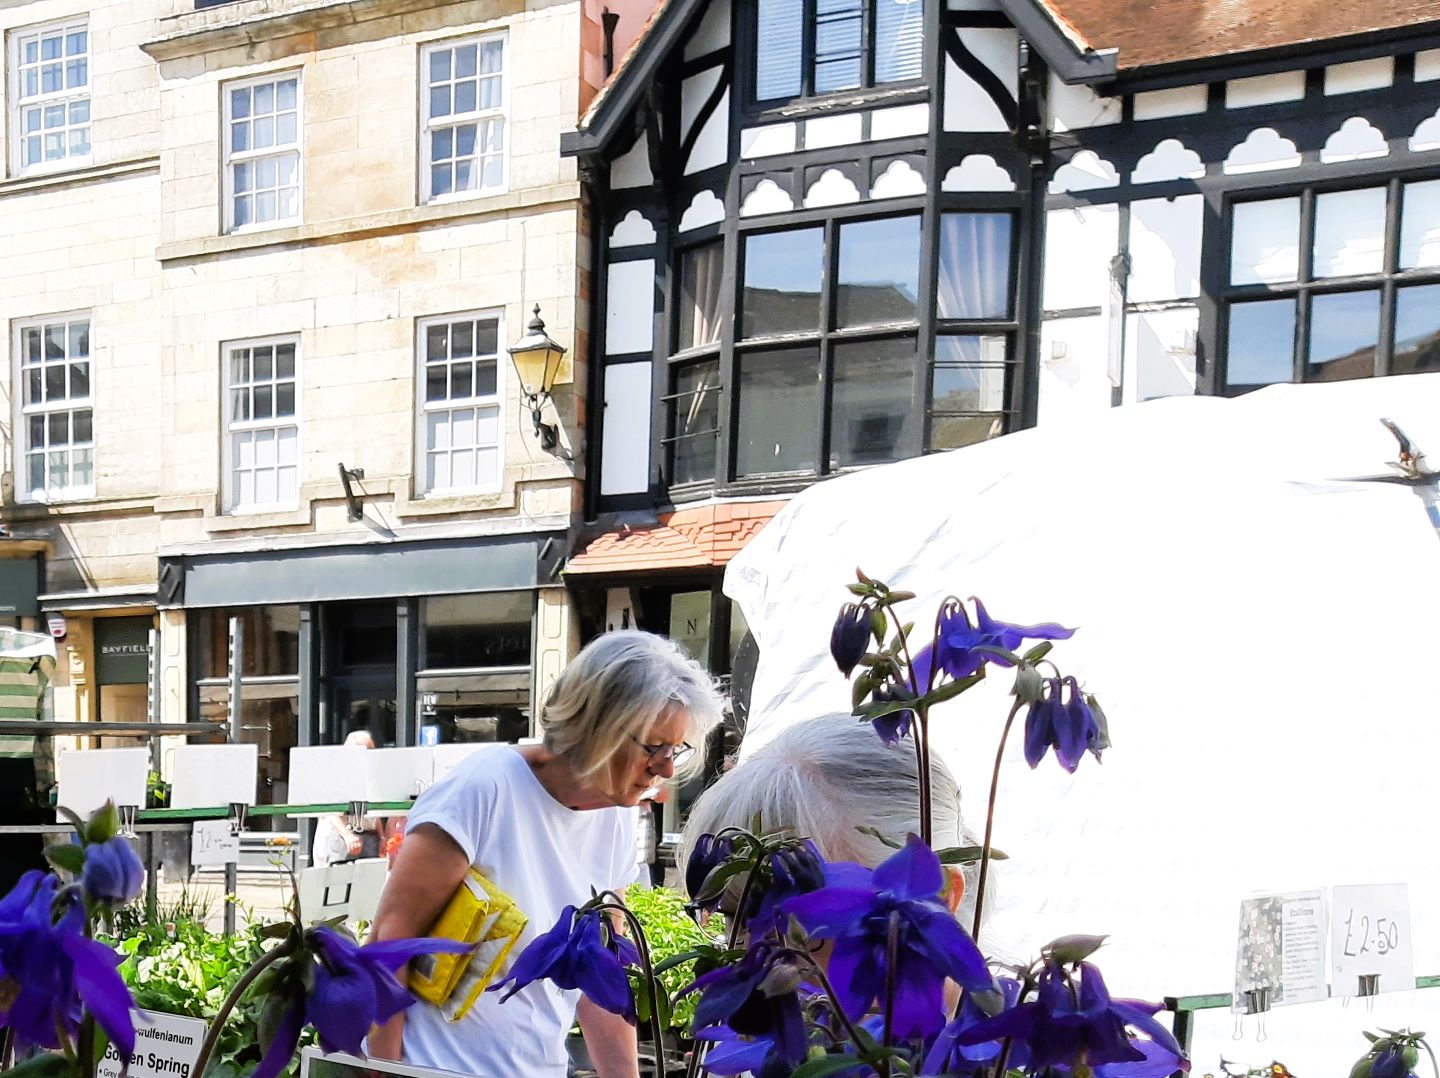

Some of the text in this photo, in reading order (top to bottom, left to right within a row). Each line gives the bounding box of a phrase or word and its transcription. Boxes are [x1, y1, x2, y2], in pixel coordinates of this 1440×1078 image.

[1344, 908, 1399, 956] £2.50
[105, 1045, 143, 1066] Goen
[148, 1053, 190, 1078] Spring
